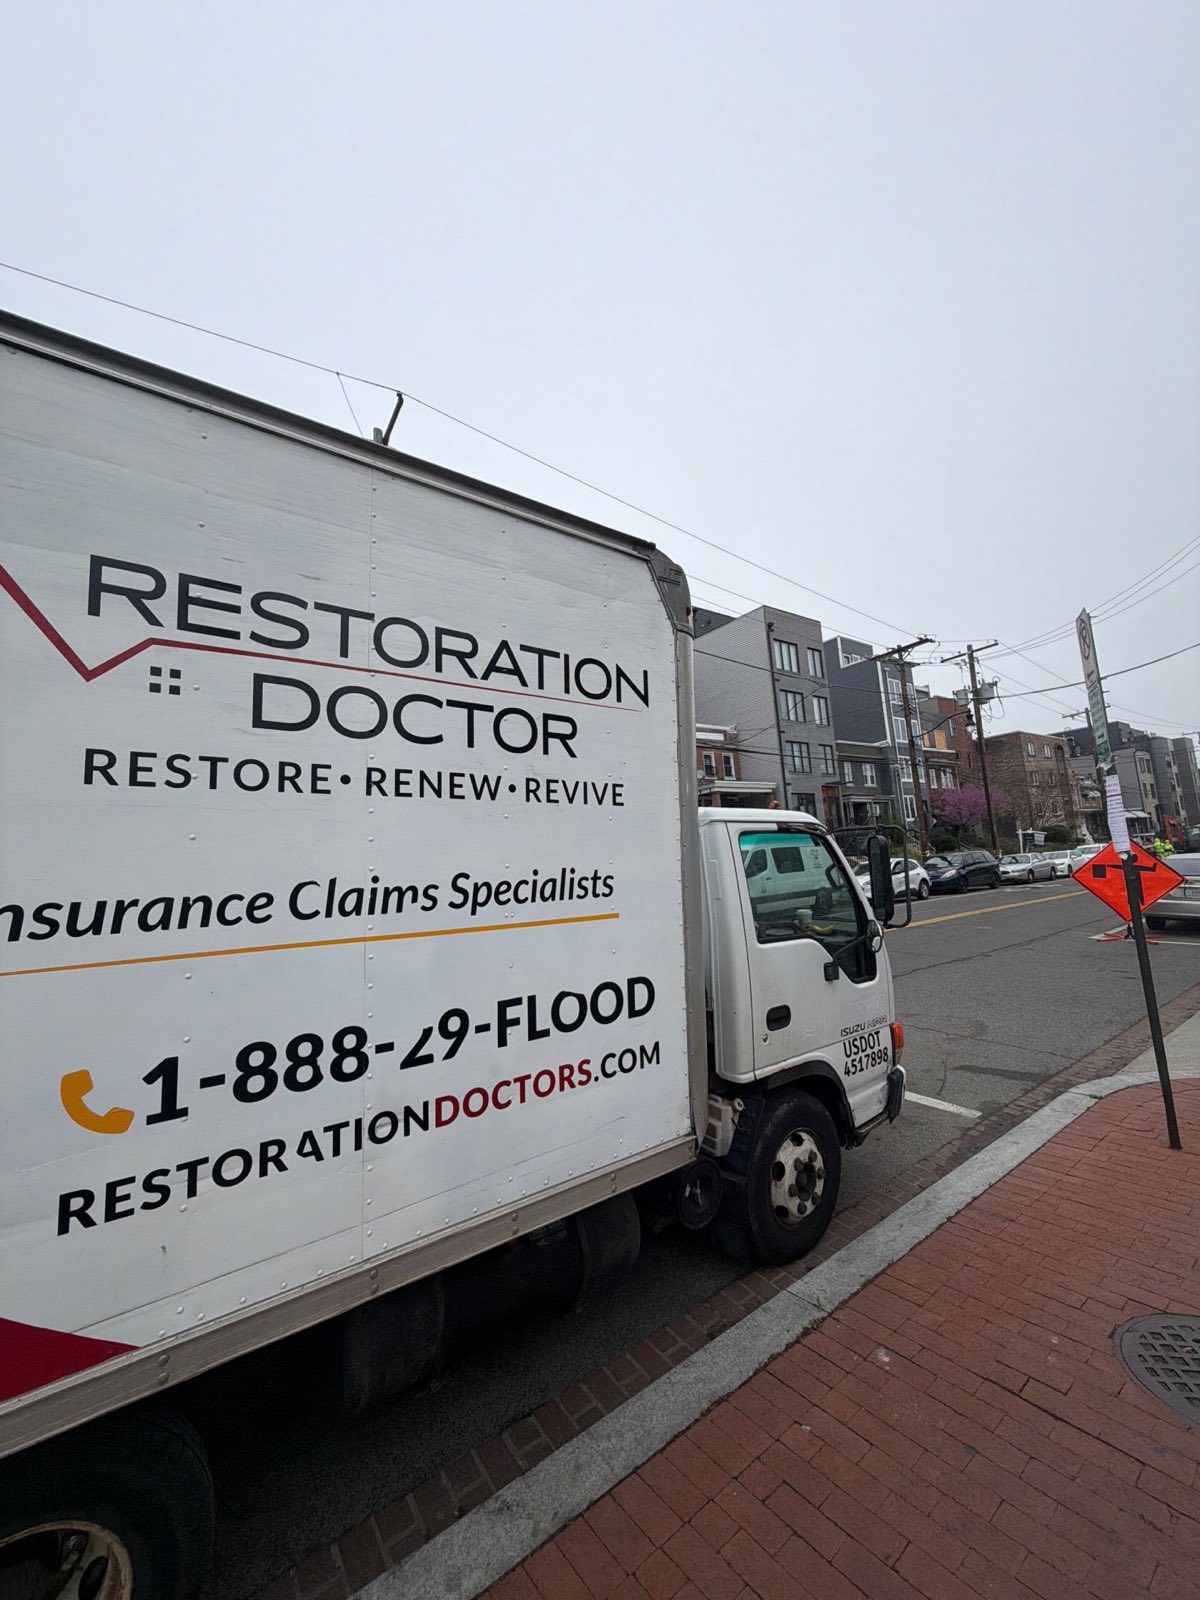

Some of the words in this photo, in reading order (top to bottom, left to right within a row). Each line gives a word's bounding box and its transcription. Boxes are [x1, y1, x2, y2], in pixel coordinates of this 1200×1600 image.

[87, 554, 650, 708] RESTORATION
[251, 672, 578, 759] DOCTOR
[83, 748, 332, 795] RESTORE
[365, 766, 502, 801] RENEW
[525, 777, 625, 807] REVIVE
[288, 875, 440, 921] Claims
[447, 867, 615, 916] Specialists
[840, 1021, 866, 1038] ISUZU
[843, 1030, 881, 1058] USDOT
[843, 1046, 889, 1077] 4517898
